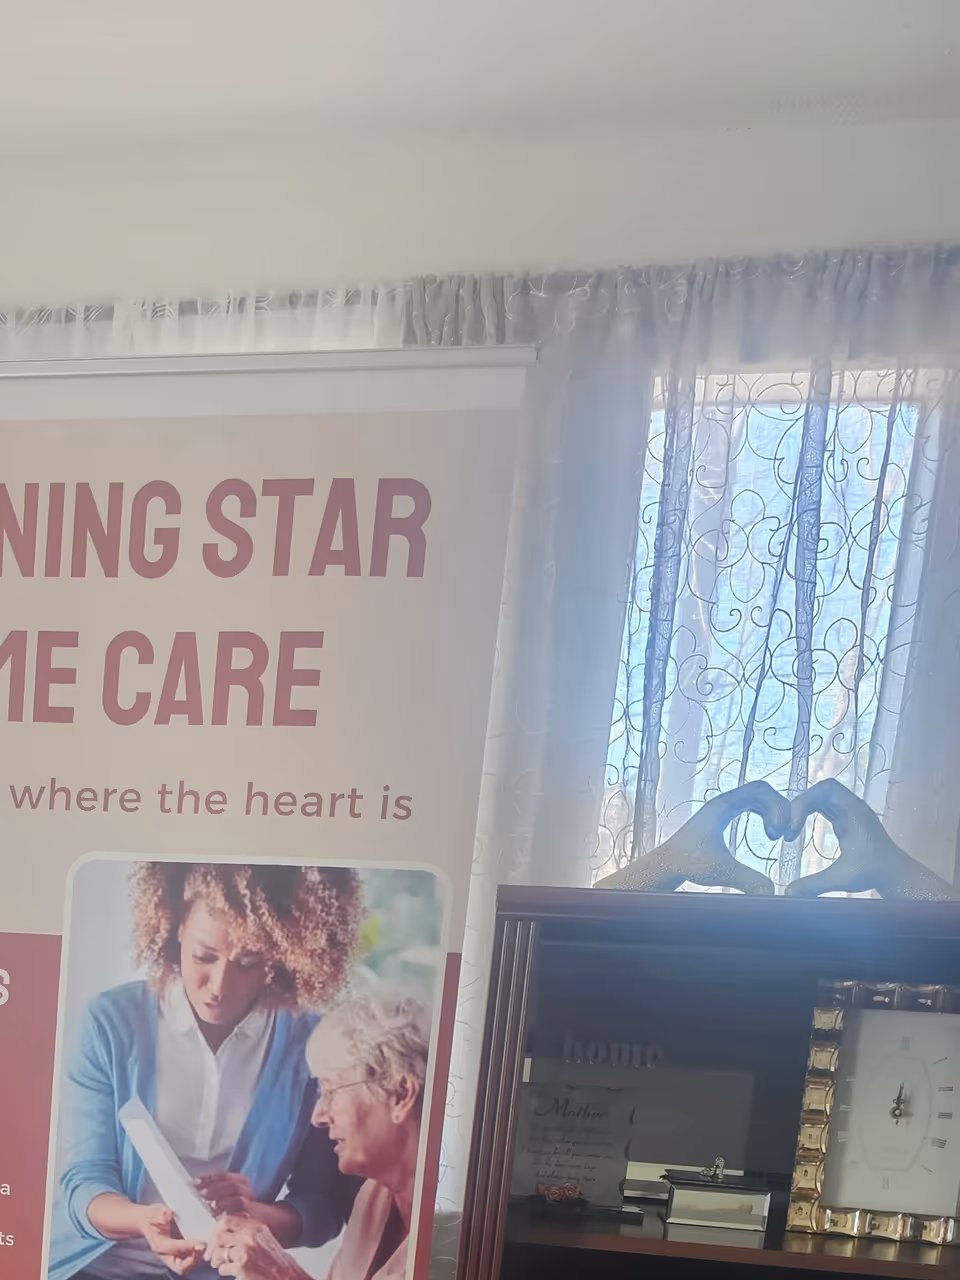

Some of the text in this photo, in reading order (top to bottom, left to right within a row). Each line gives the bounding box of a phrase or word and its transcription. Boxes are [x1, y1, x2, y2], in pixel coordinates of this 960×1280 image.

[202, 477, 433, 580] STAR
[101, 629, 326, 728] CARE
[8, 777, 142, 813] where
[157, 779, 228, 816] the
[244, 781, 363, 820] heart
[380, 784, 414, 822] is
